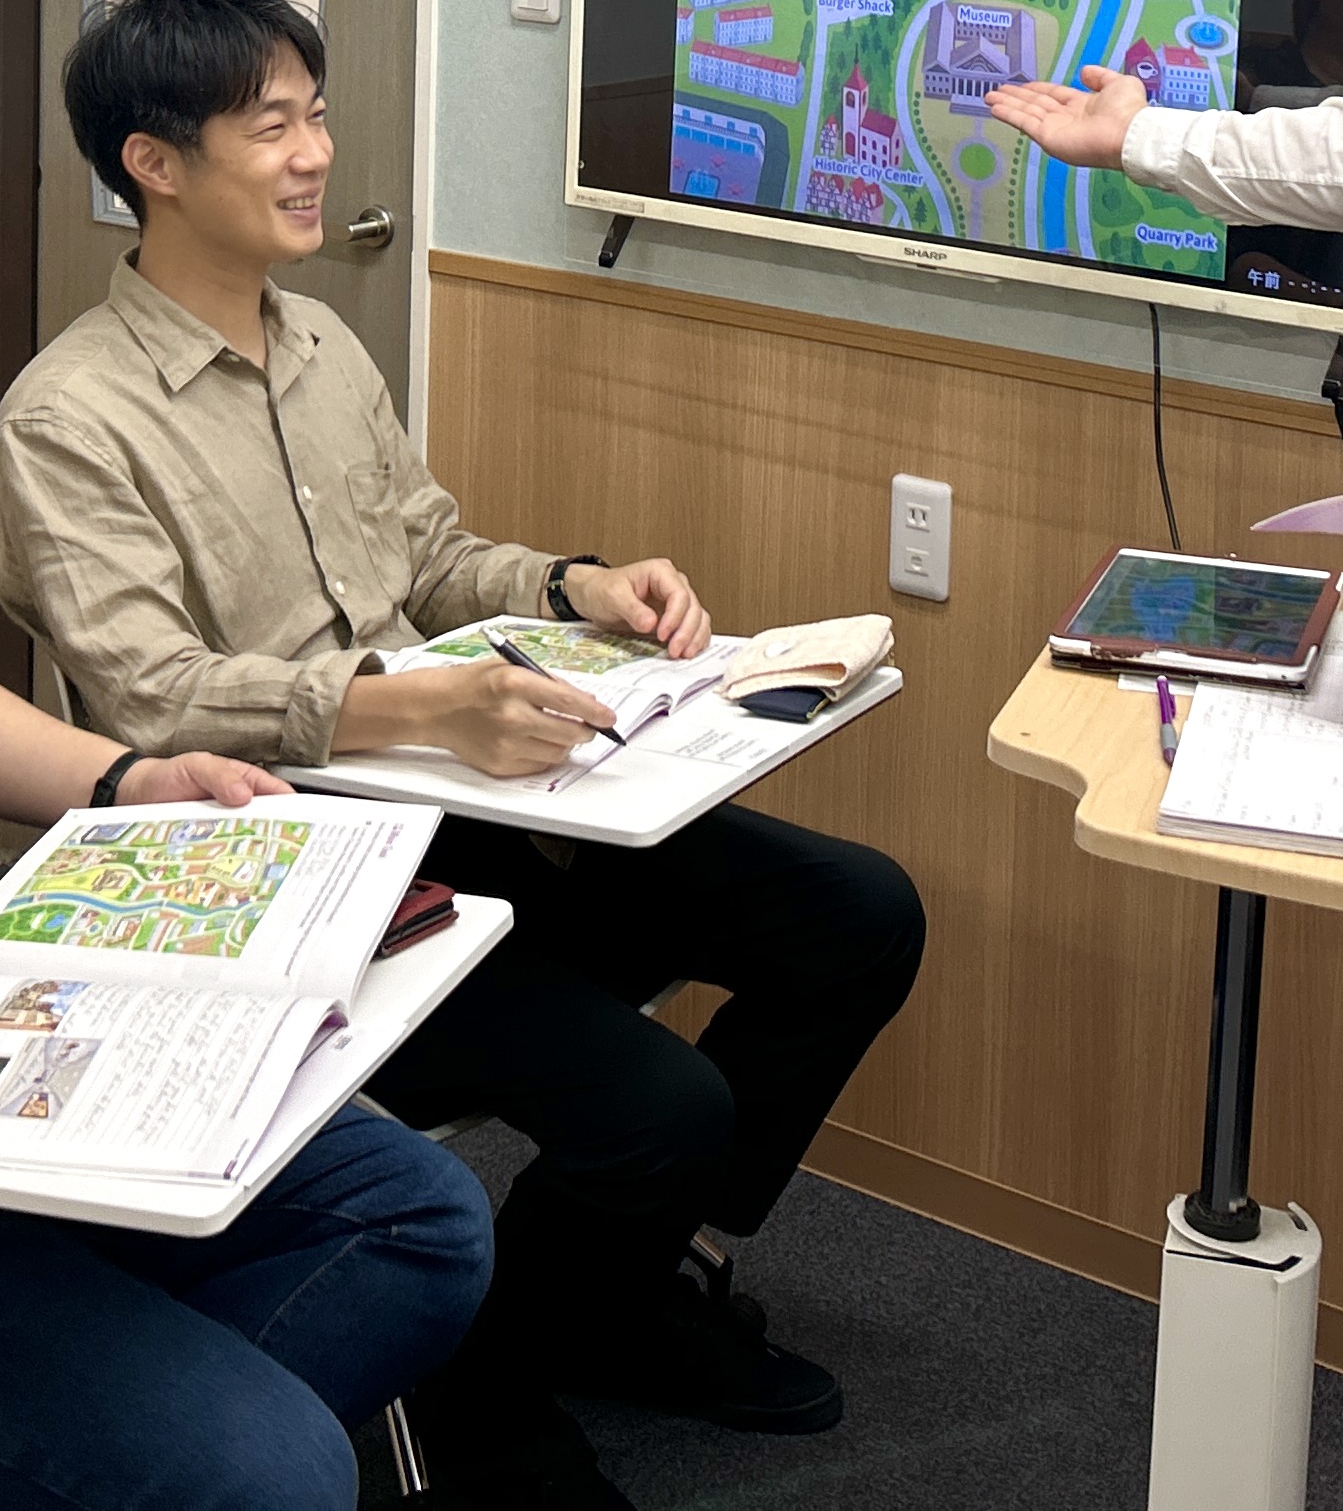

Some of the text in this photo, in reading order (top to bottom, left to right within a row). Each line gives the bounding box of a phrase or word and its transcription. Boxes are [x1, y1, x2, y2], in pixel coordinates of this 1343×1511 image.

[959, 7, 1011, 25] Museum
[815, 157, 923, 186] Historic City Center
[1137, 225, 1216, 250] Quarry Park
[904, 246, 947, 262] SHARP
[1247, 268, 1281, 291] 午前
